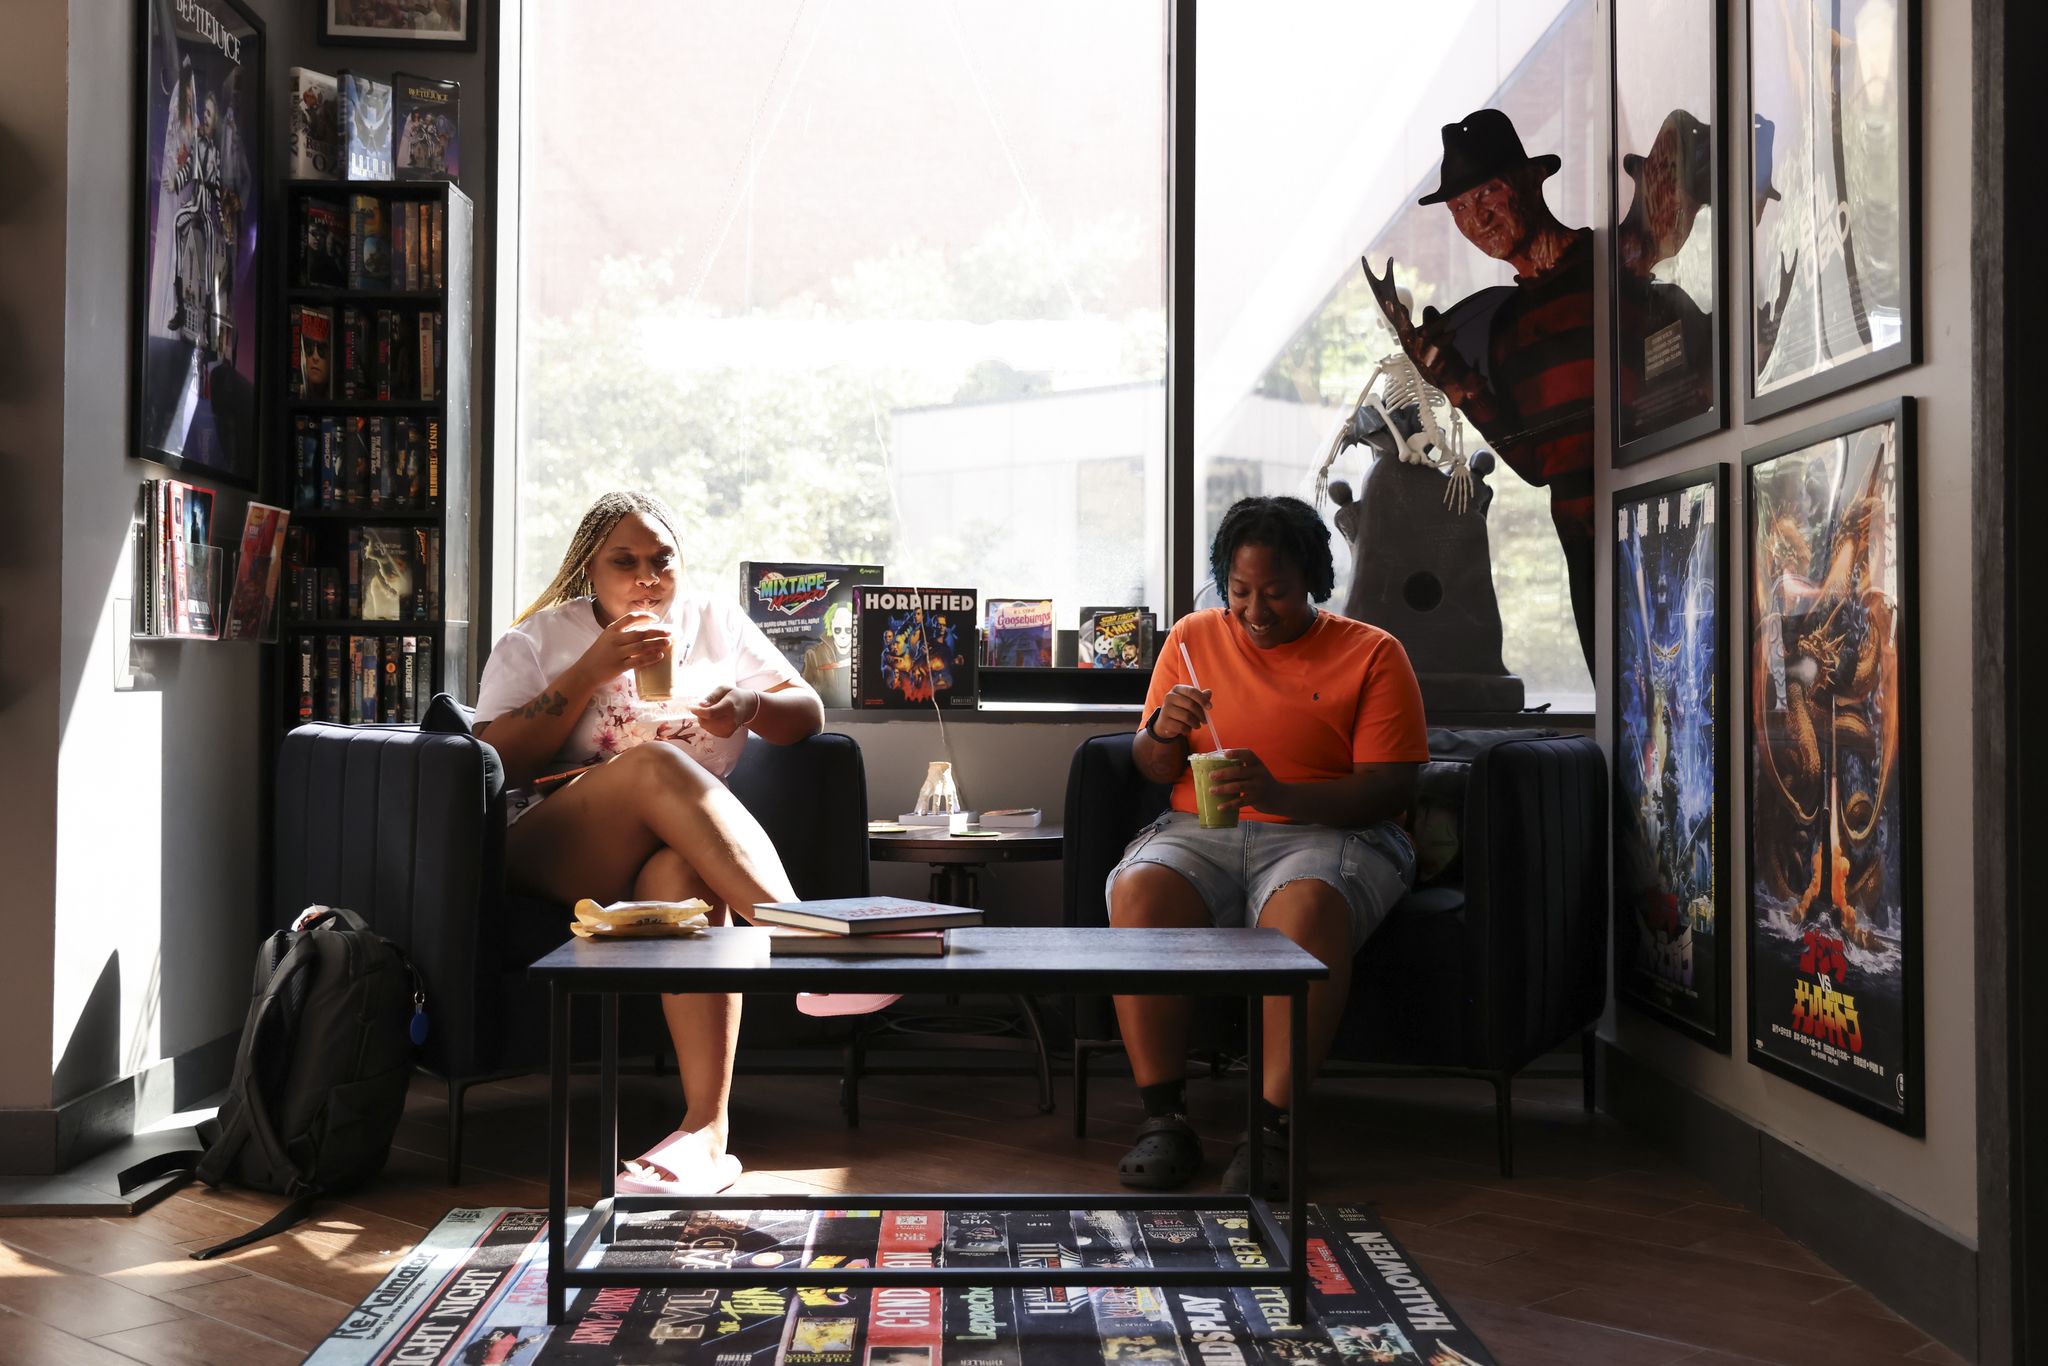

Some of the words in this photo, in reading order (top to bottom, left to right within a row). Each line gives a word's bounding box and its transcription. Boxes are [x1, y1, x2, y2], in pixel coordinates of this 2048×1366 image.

[408, 88, 449, 101] BEETLEJUICE
[429, 423, 438, 450] NINJA
[760, 572, 826, 599] MIXTAPE
[866, 593, 975, 611] HORRIFIED
[997, 609, 1050, 628] Goosebumps
[1102, 622, 1137, 640] X-MEN
[1799, 928, 1848, 984] ゴジラ
[1817, 972, 1833, 993] VS
[332, 1253, 439, 1339] Re-Animator
[875, 1252, 932, 1327] CANDAN
[1228, 1237, 1303, 1331] HELLISER
[1347, 1231, 1457, 1331] HALLOWEEN
[387, 1322, 461, 1366] IGHT
[430, 1269, 502, 1319] NIGHT
[649, 1289, 719, 1339] EVIL
[720, 1287, 786, 1320] THIN
[955, 1287, 1008, 1340] Leprech
[1179, 1294, 1229, 1331] PLAY
[565, 1318, 623, 1346] ARMY
